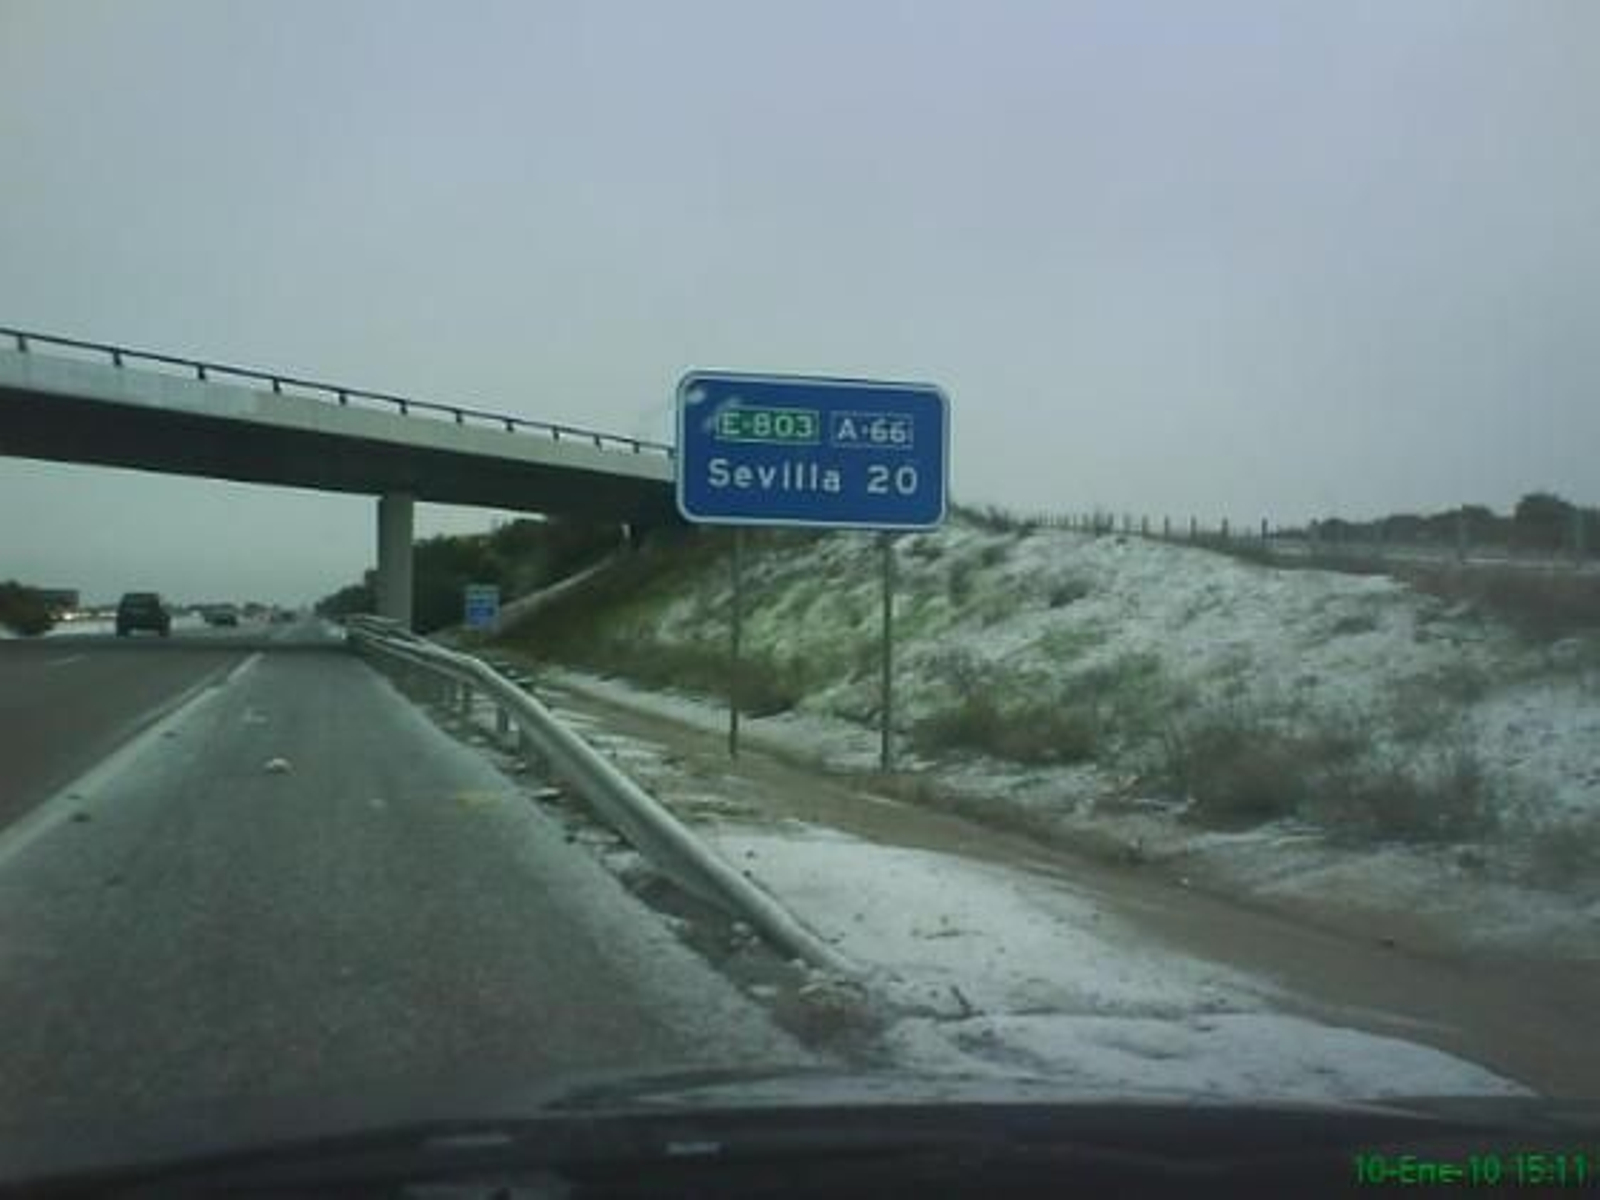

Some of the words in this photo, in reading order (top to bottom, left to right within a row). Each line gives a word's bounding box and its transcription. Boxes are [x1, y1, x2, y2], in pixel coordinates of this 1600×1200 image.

[721, 412, 814, 437] E-803
[837, 418, 907, 443] A-66
[708, 458, 841, 492] Sevilla
[867, 464, 918, 495] 20
